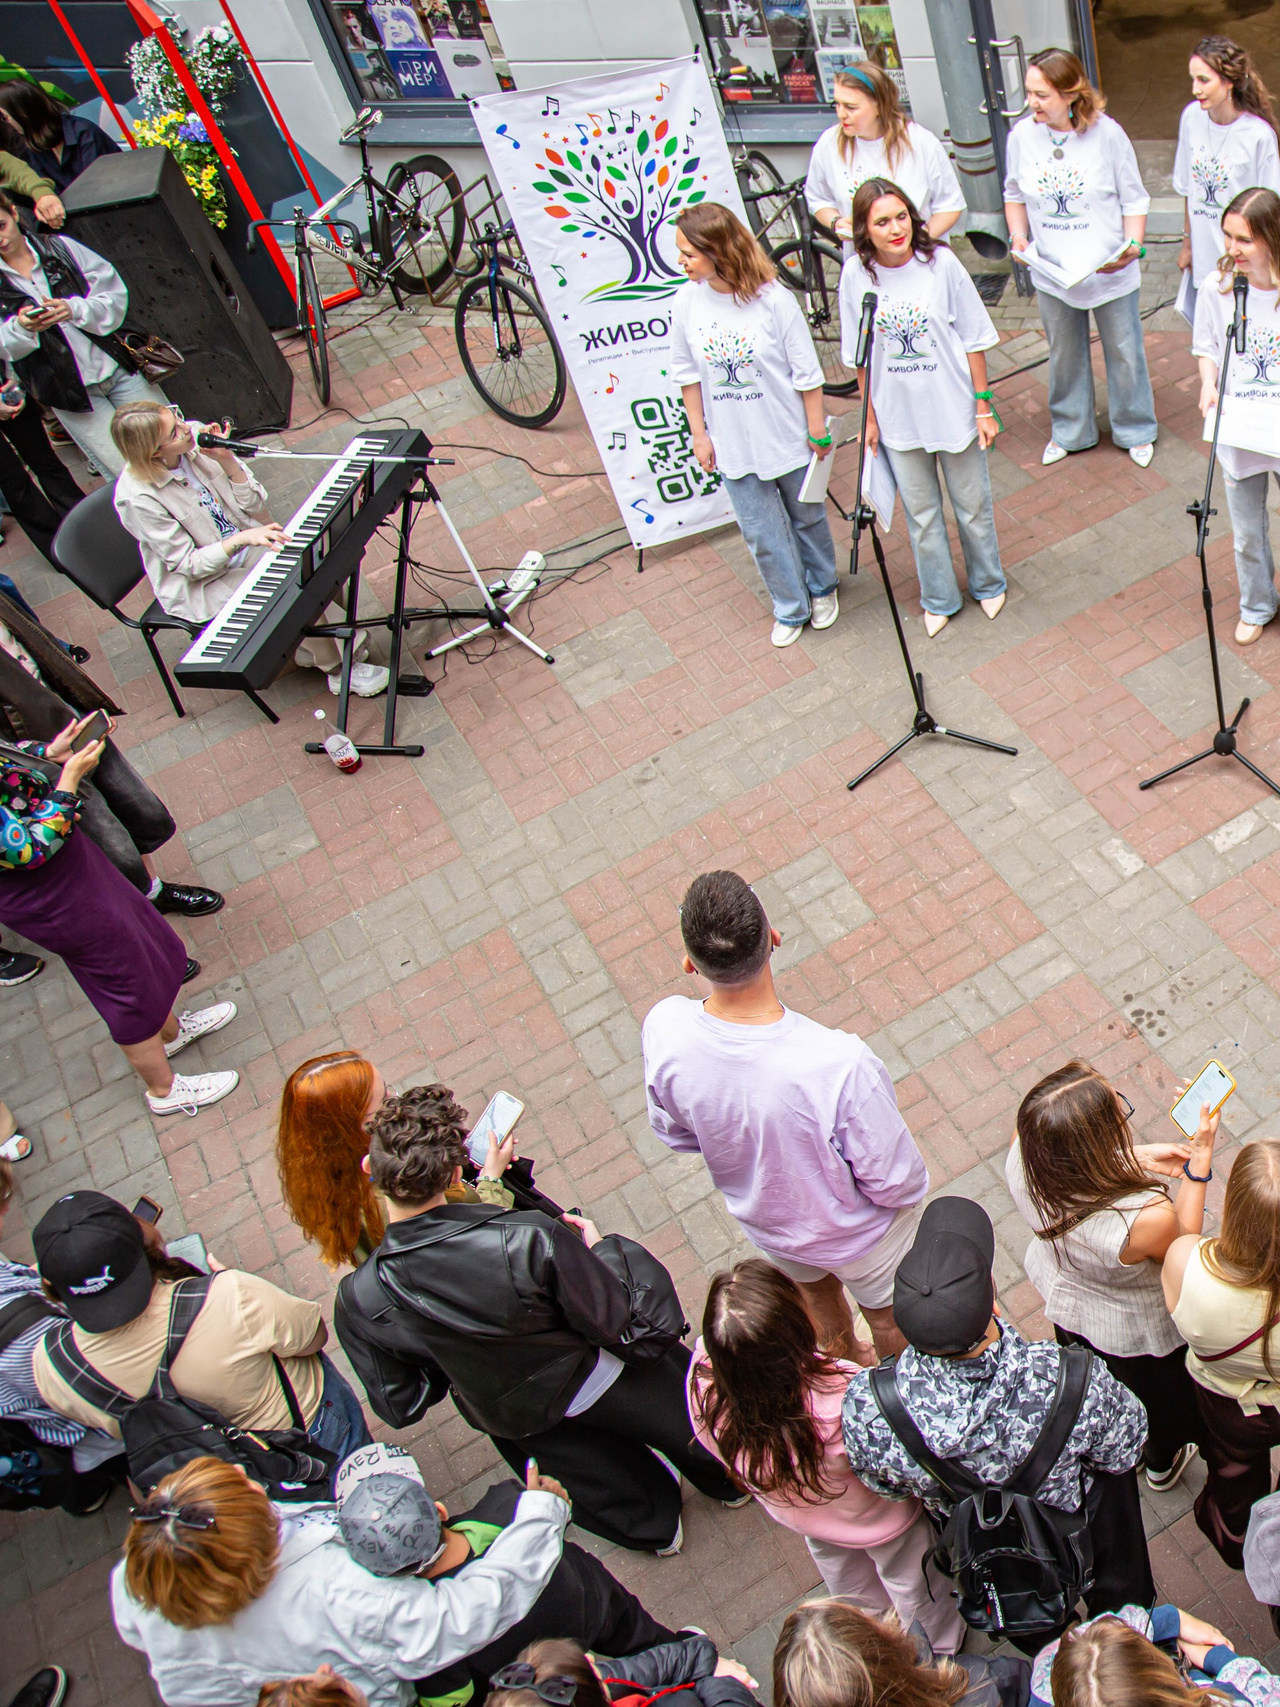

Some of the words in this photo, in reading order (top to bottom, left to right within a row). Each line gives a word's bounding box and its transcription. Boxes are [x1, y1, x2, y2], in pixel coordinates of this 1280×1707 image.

[399, 61, 437, 75] ПРИ
[1041, 222, 1070, 231] ЖИВОЙ
[1073, 223, 1090, 231] ХОР
[587, 352, 623, 366] Репетиции
[631, 345, 671, 356] Выступлени
[886, 362, 920, 373] ЖИВОЙ
[922, 362, 938, 373] ХОР
[712, 391, 743, 402] ЖИВОЙ
[745, 392, 764, 402] ХОР
[1234, 389, 1268, 398] ЖИВОЙ
